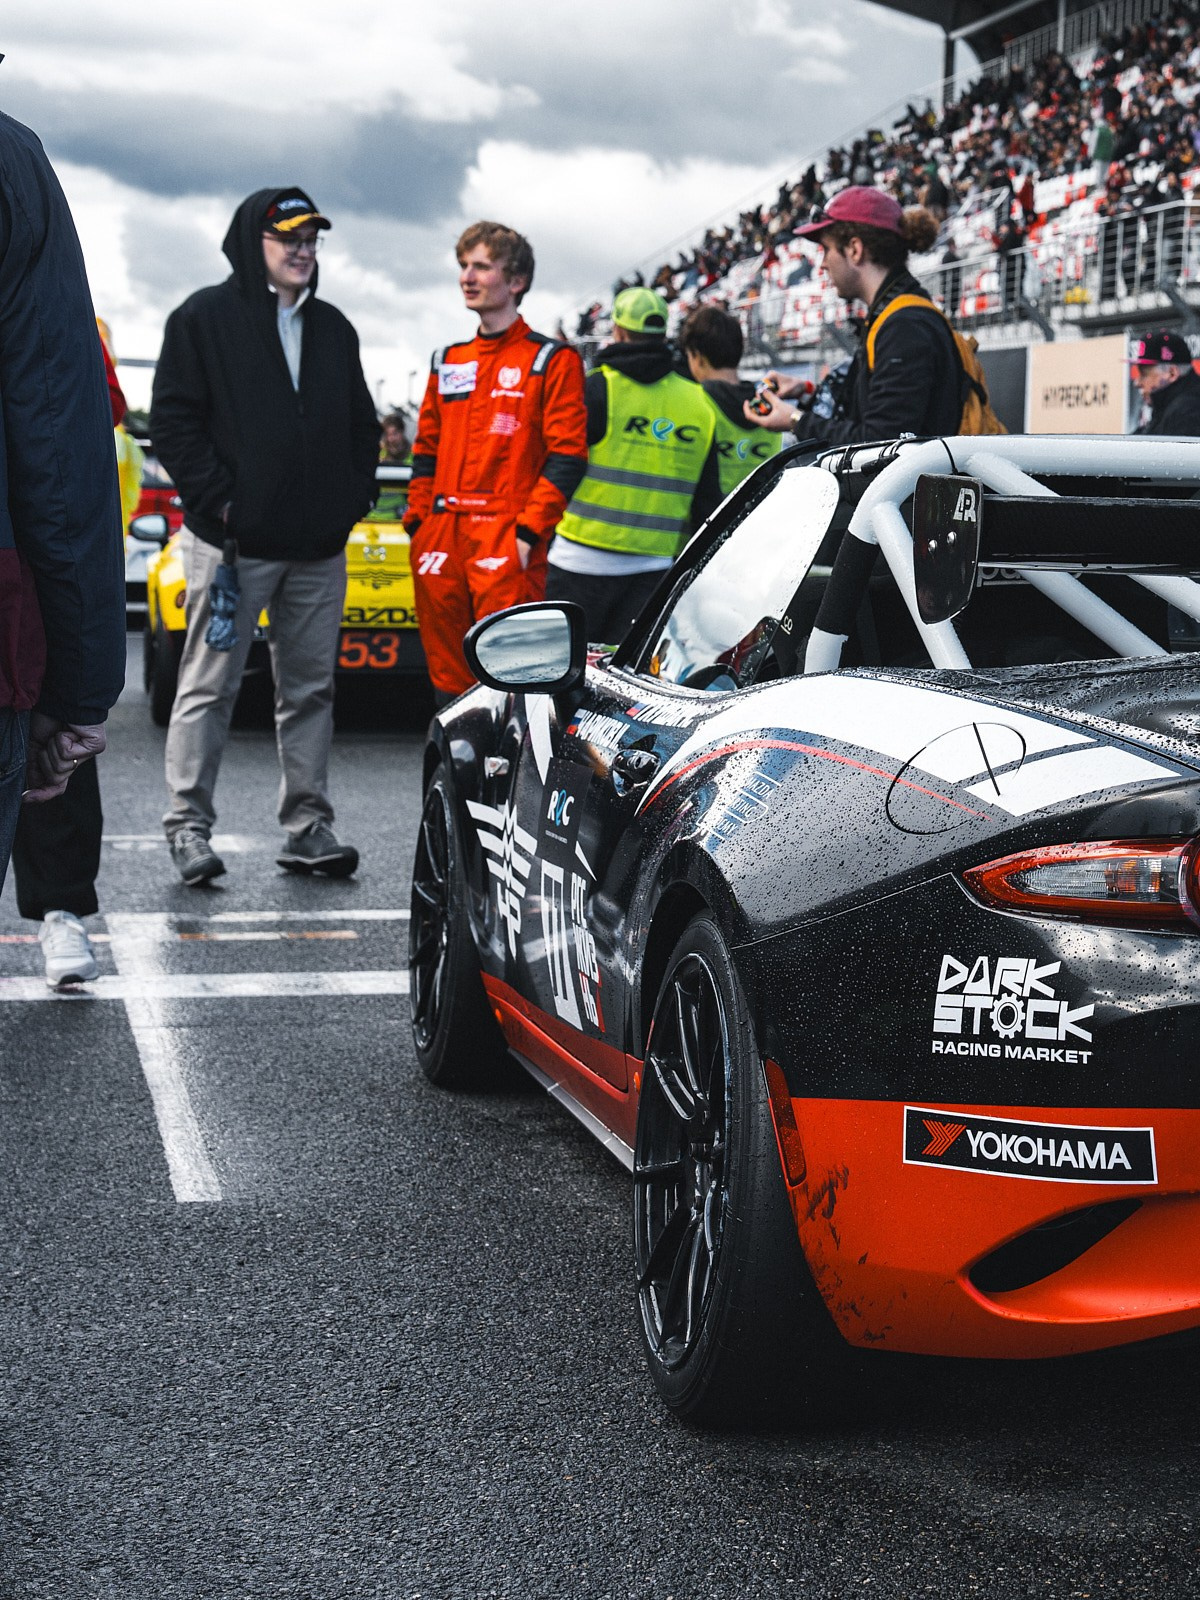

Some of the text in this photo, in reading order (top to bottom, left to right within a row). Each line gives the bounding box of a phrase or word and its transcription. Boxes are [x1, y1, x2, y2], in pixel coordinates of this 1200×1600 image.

[1041, 382, 1109, 407] HYPERCAR
[339, 631, 399, 669] 53
[936, 954, 1062, 999] DARK
[933, 992, 1095, 1043] STOCK
[931, 1040, 1093, 1064] RACING MARKET
[966, 1128, 1132, 1170] YOKOHAMA
